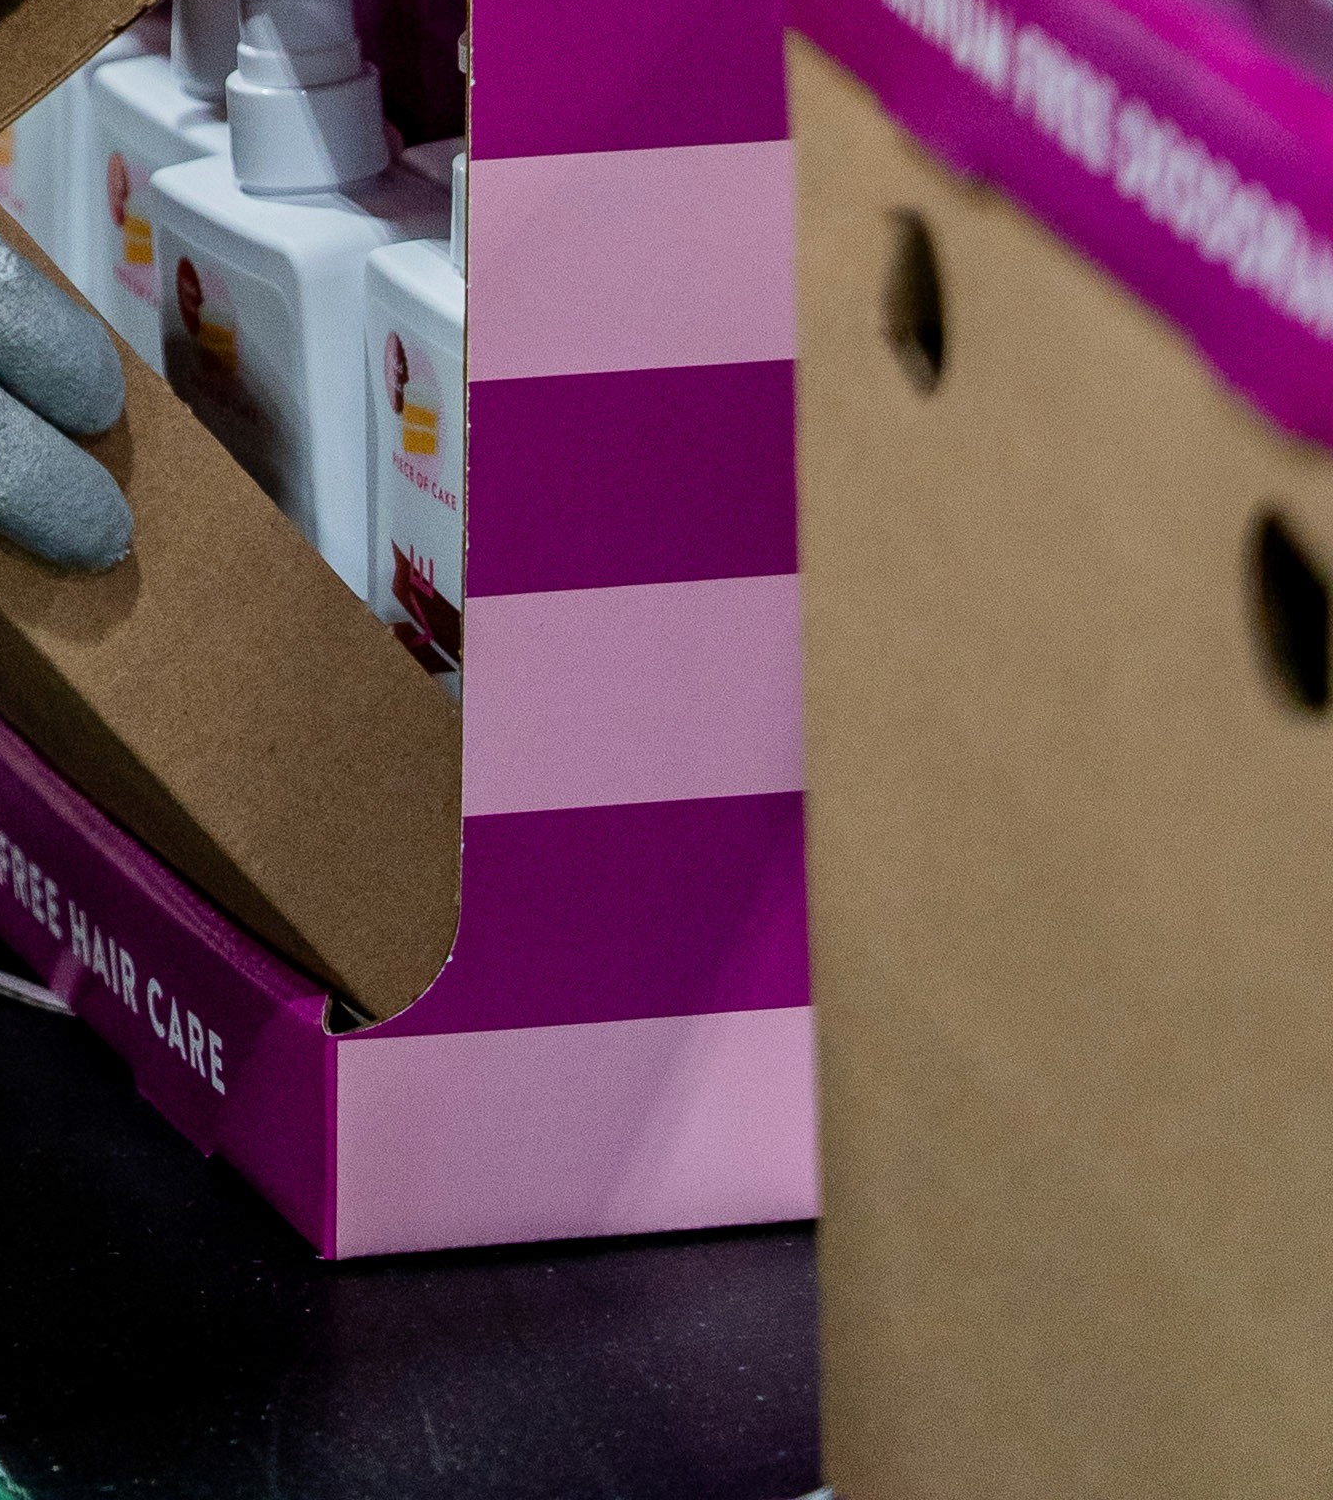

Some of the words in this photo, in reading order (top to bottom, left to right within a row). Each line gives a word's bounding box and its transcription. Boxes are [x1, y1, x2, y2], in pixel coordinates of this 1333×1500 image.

[1015, 20, 1120, 177] FREE
[416, 471, 429, 493] OF
[432, 481, 457, 512] CAKE
[68, 899, 139, 1015] HAIR
[147, 976, 226, 1096] CARE
